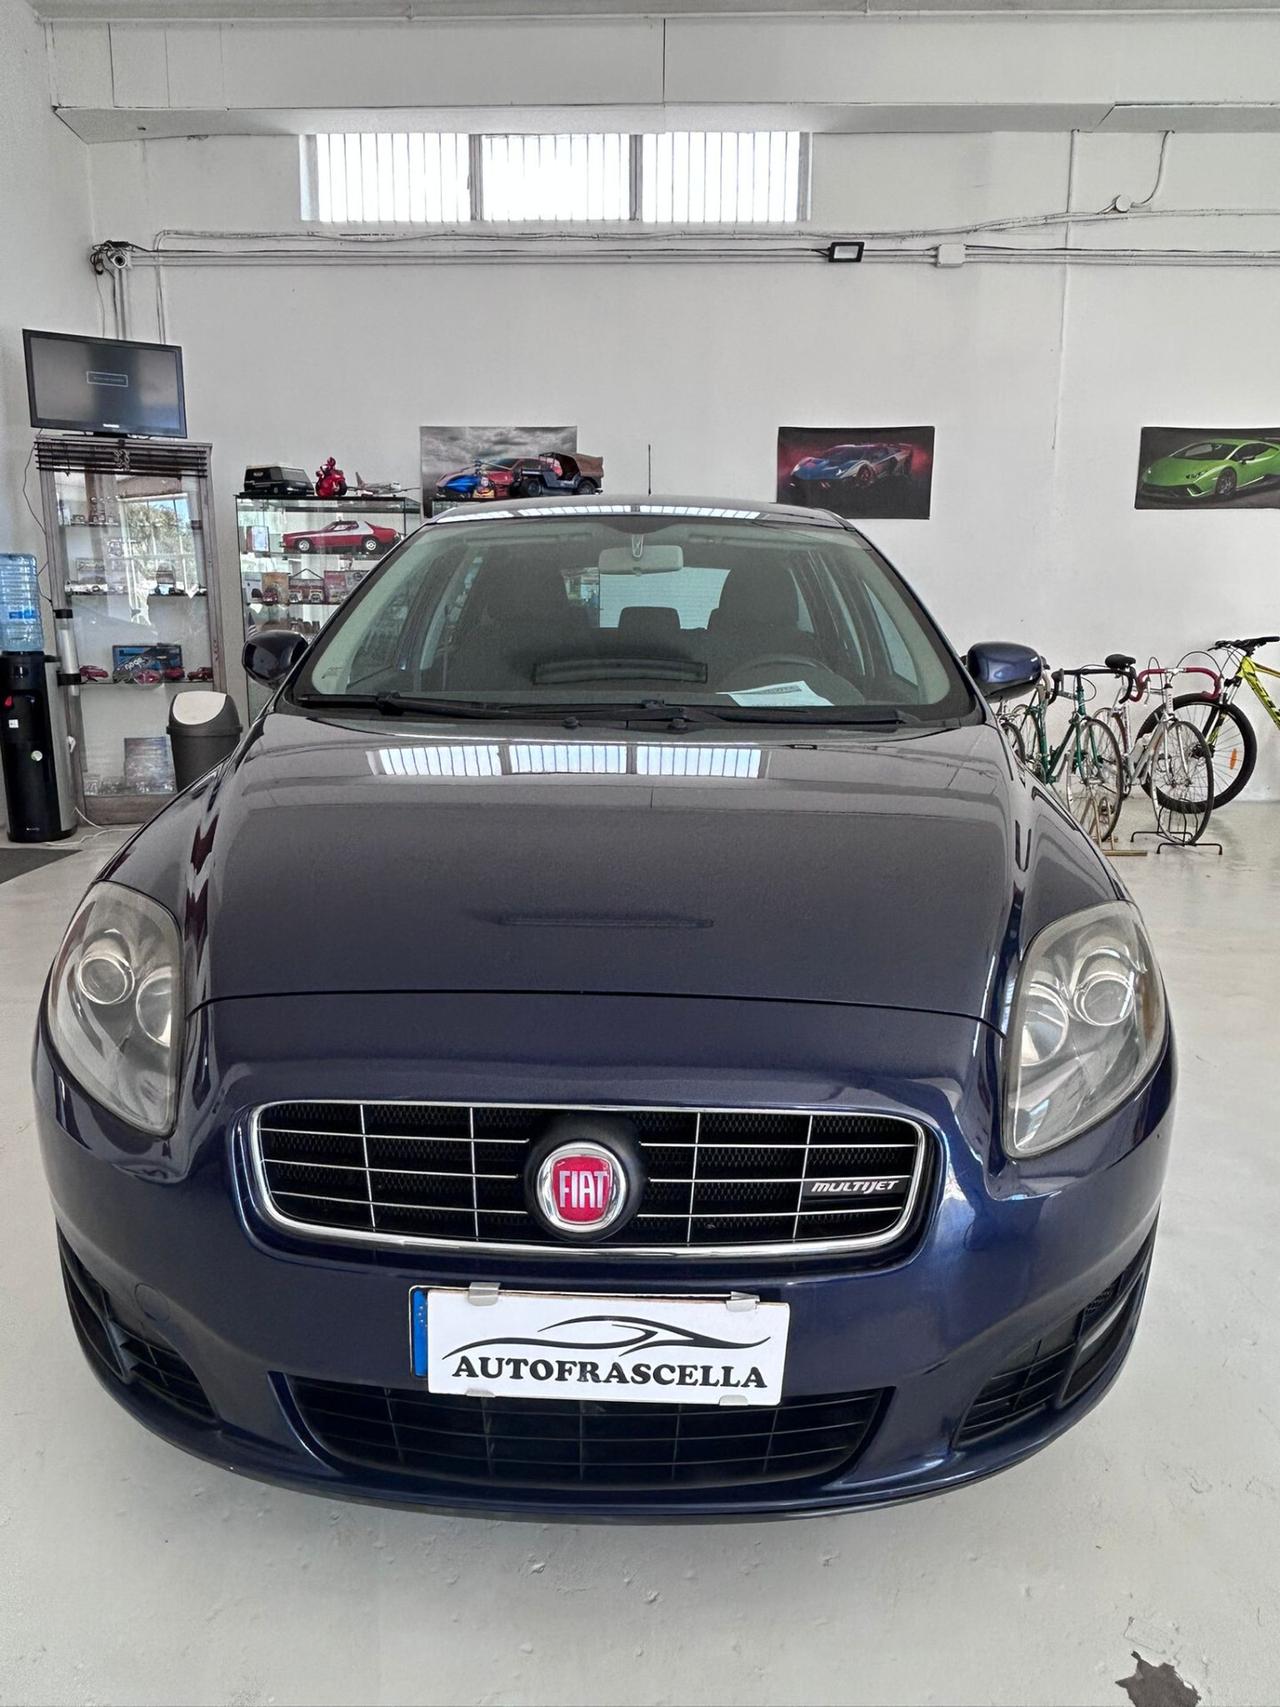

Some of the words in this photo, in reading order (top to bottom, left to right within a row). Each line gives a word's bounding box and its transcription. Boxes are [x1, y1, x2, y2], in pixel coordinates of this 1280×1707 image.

[559, 1170, 609, 1209] FIAT
[811, 1180, 899, 1194] MULTIJET
[452, 1355, 767, 1388] AUTOFRASCELLA
